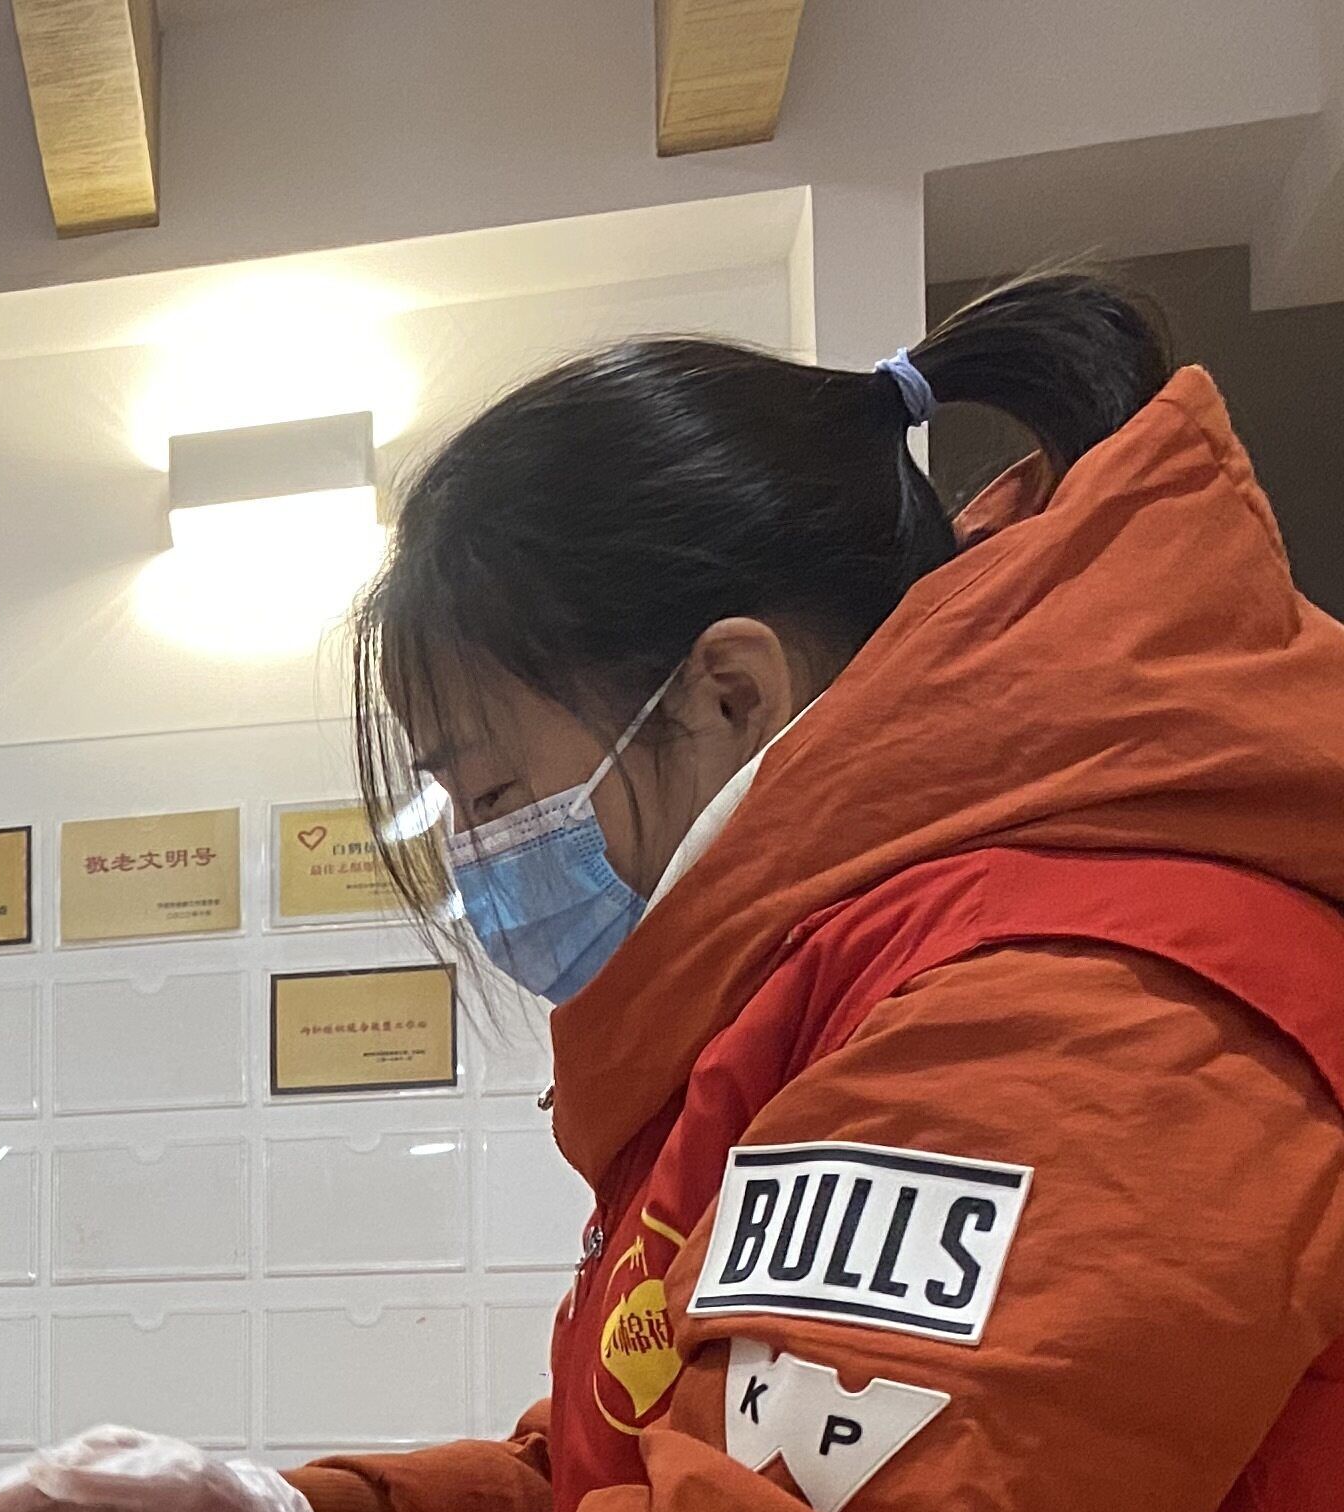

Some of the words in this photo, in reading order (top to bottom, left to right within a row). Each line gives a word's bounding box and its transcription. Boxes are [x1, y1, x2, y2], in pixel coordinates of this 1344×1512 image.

[84, 847, 217, 875] 敬老文明号
[717, 1172, 998, 1310] BULLS
[738, 1374, 771, 1425] K
[818, 1413, 864, 1456] P
